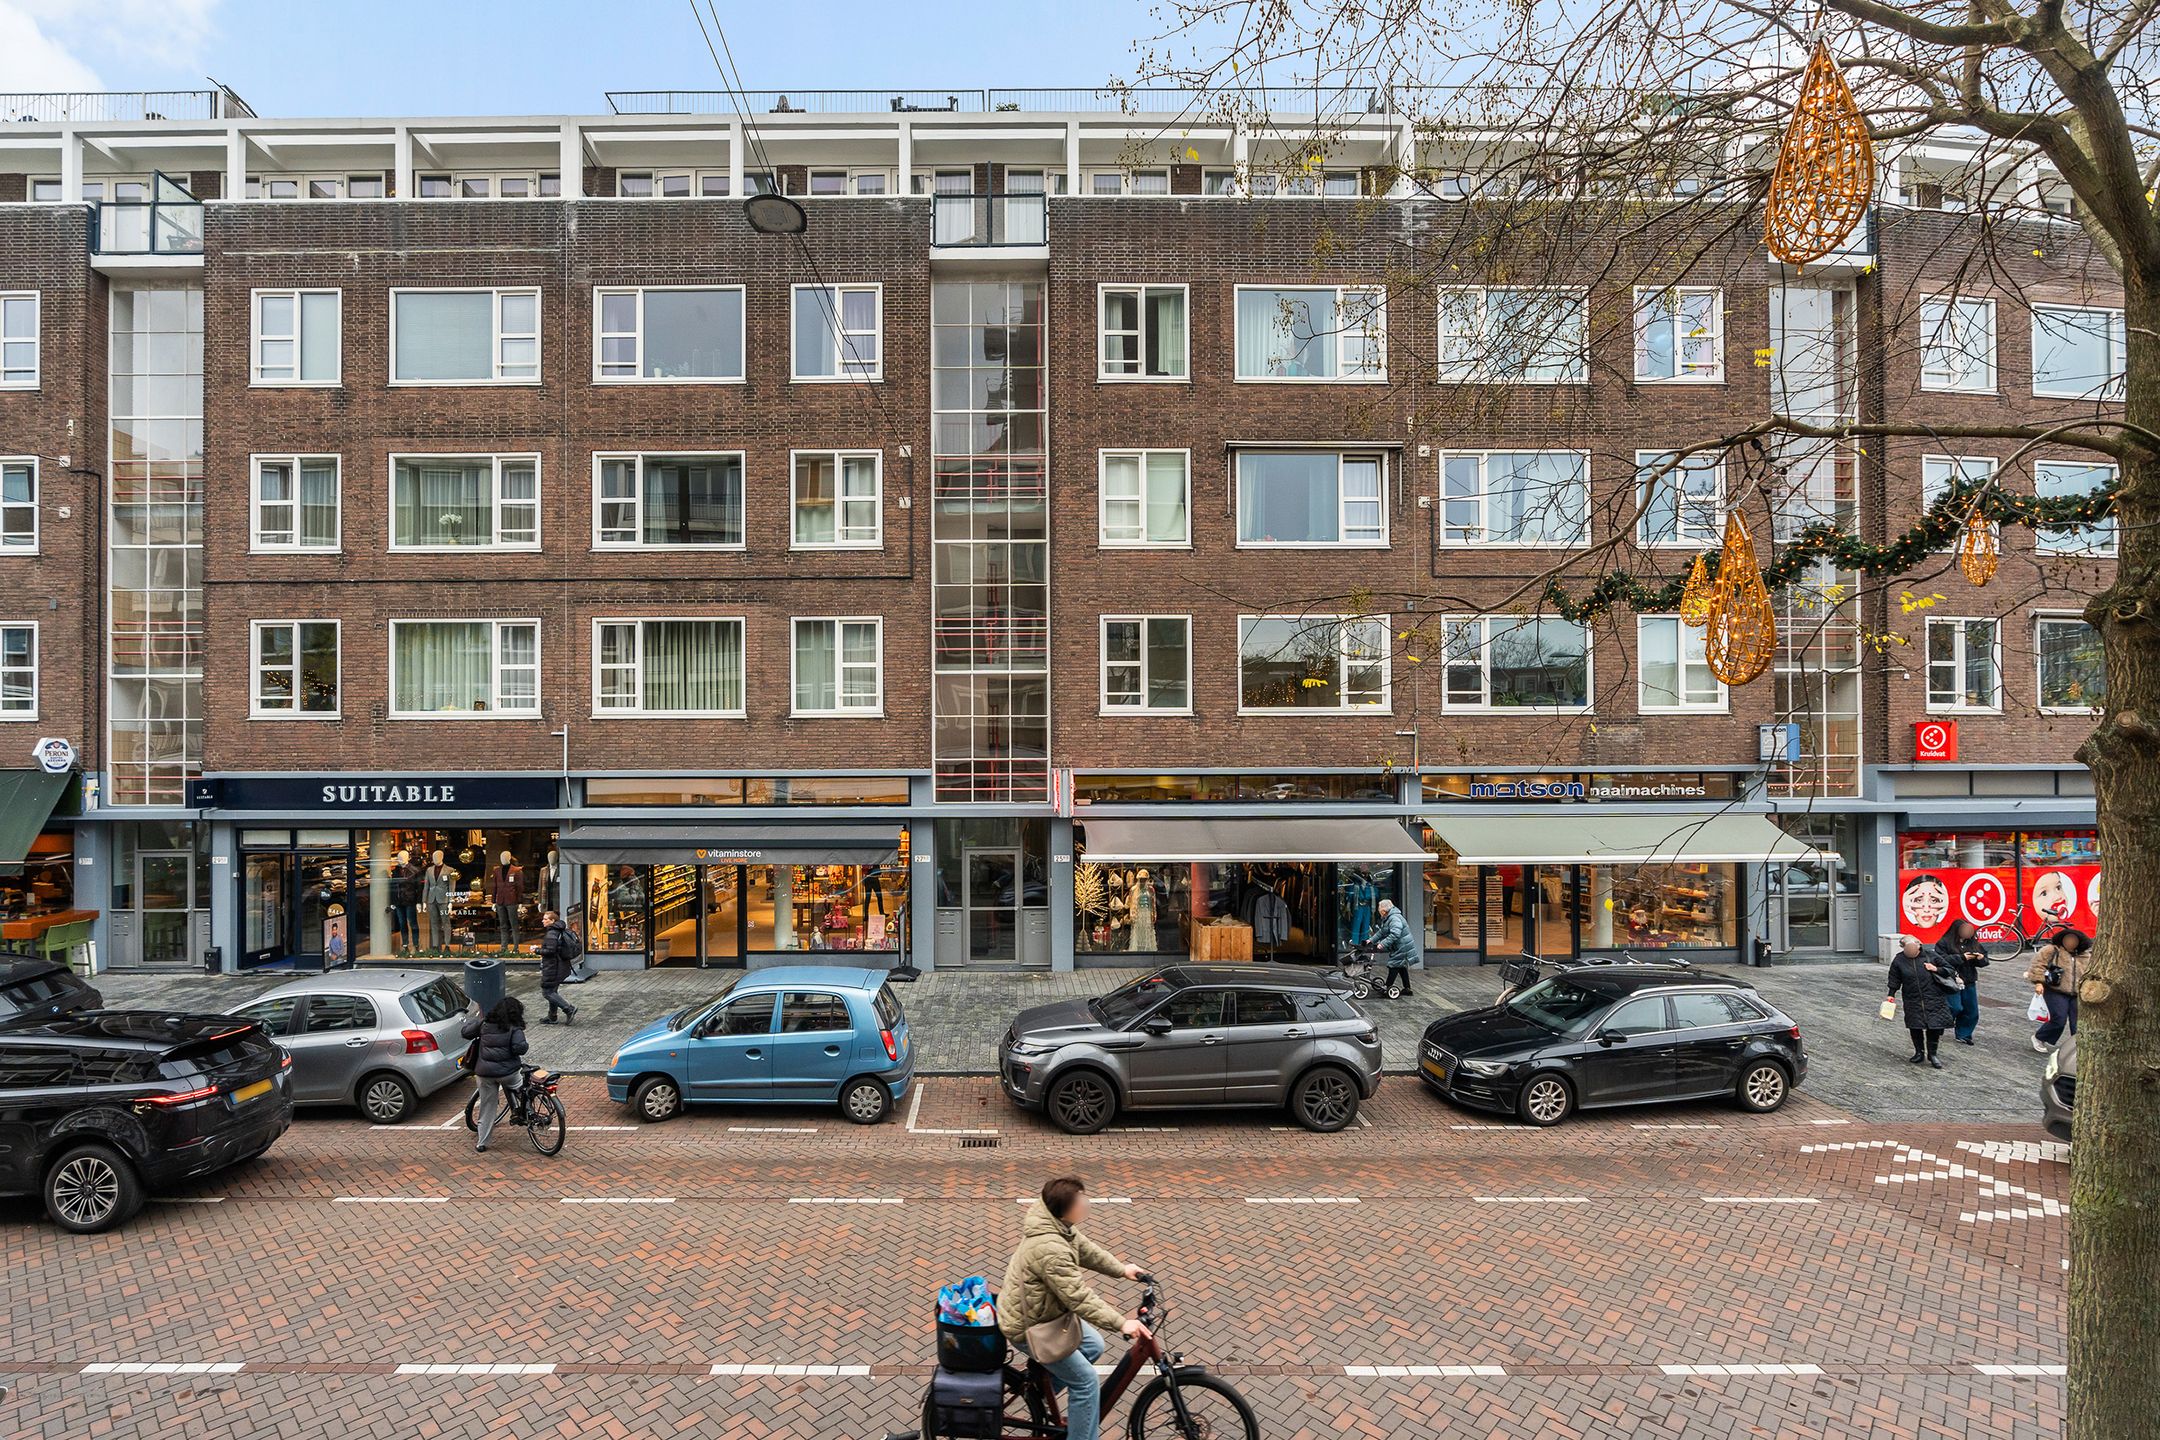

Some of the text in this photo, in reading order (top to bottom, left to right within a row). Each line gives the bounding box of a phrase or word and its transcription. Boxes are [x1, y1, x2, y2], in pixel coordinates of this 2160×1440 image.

[322, 785, 456, 803] SUITABLE
[1470, 780, 1706, 797] matson naaimachines
[708, 849, 762, 858] vitaminstore
